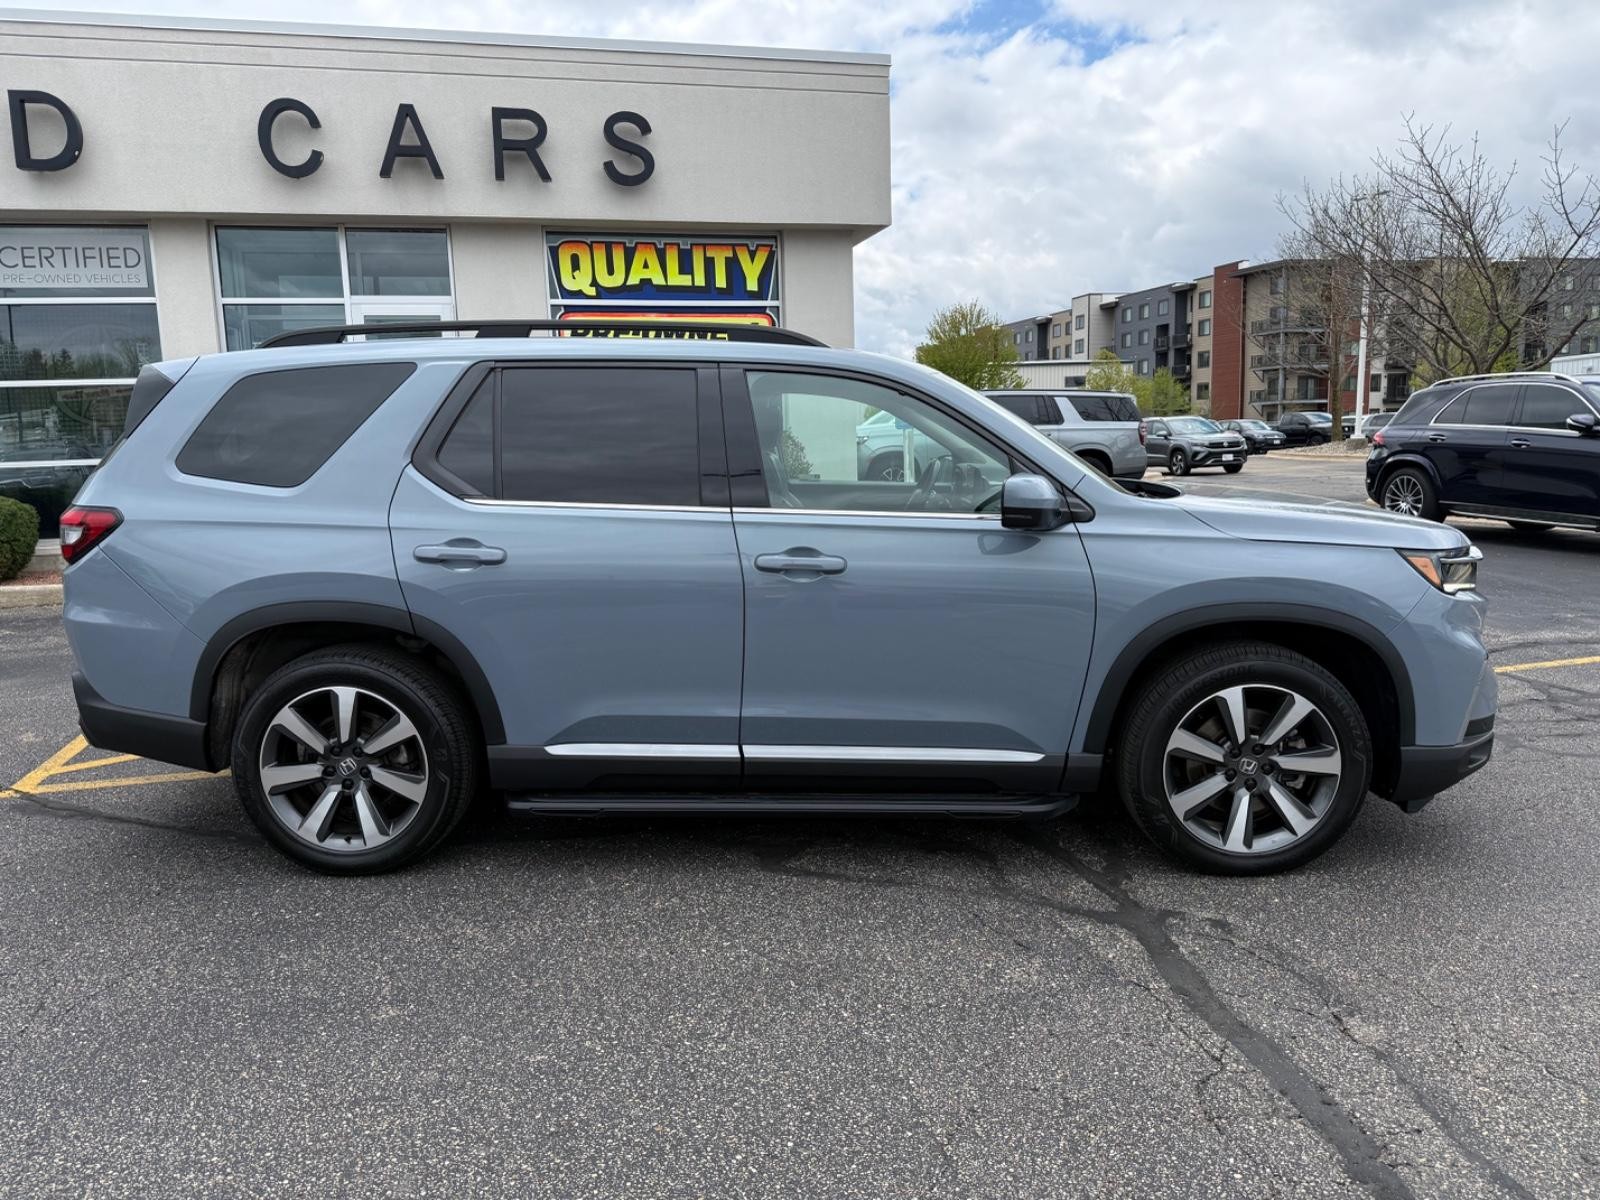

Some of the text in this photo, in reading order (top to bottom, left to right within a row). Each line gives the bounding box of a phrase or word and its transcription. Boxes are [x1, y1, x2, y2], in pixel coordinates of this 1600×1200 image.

[258, 97, 655, 187] CARS
[0, 245, 142, 269] CERTIFIED
[558, 241, 770, 296] QUALITY
[3, 273, 141, 284] PRE-OWNED VEHICLES
